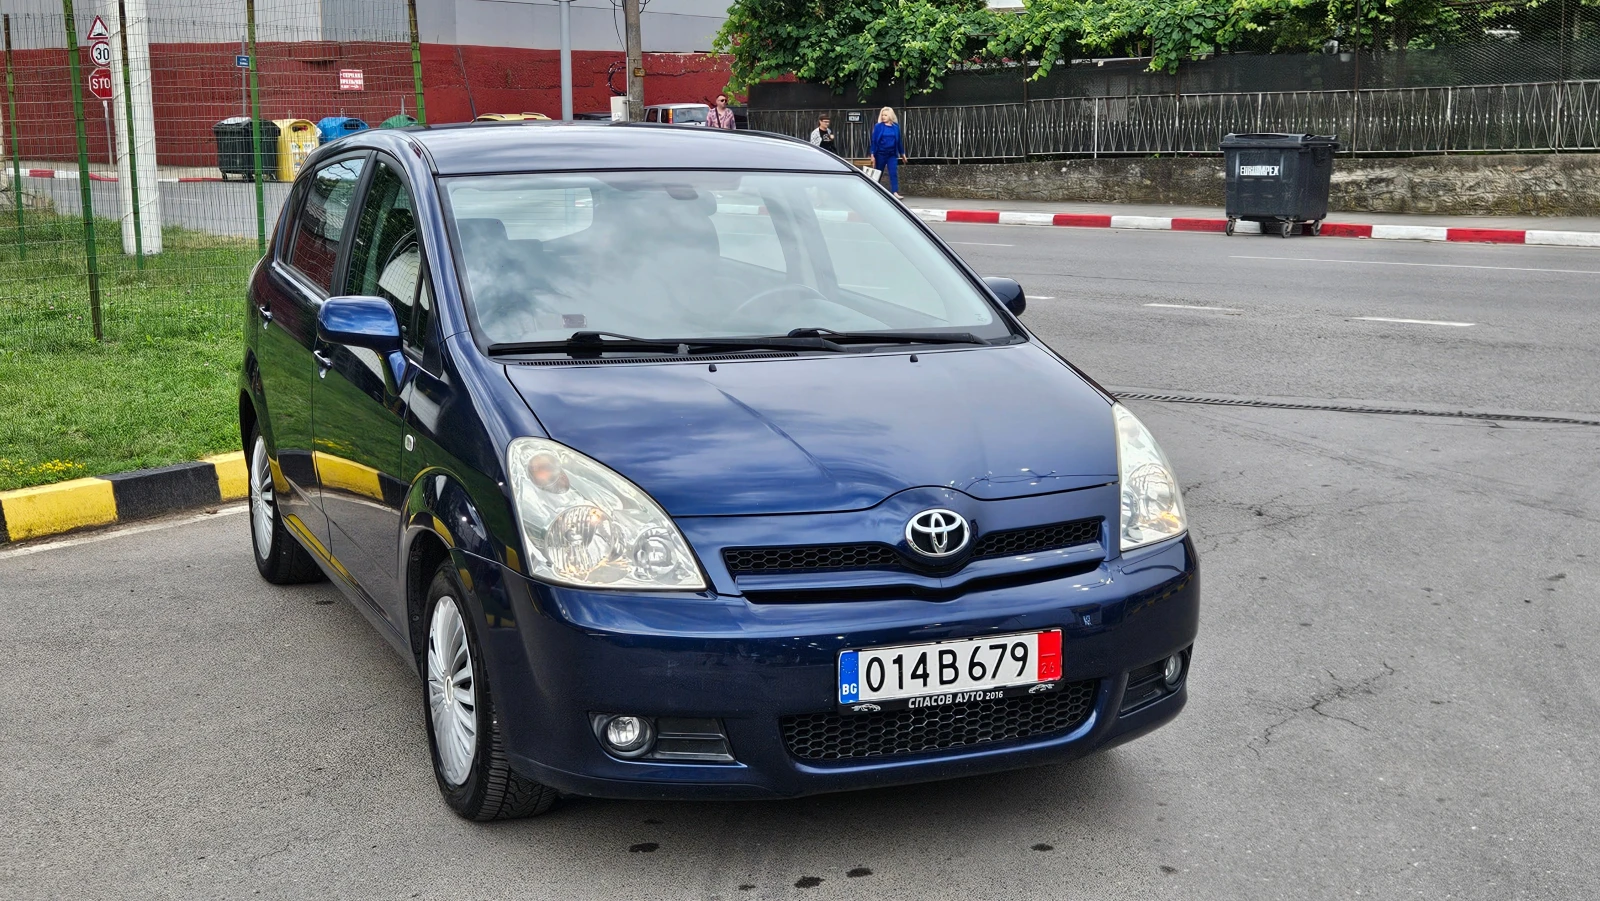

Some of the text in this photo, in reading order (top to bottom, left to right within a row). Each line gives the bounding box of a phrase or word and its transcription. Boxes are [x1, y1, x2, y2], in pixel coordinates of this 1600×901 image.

[95, 47, 110, 61] 30
[92, 78, 111, 89] STO
[842, 683, 858, 695] BG
[908, 691, 1004, 709] СПАСОВ АУТО 2016
